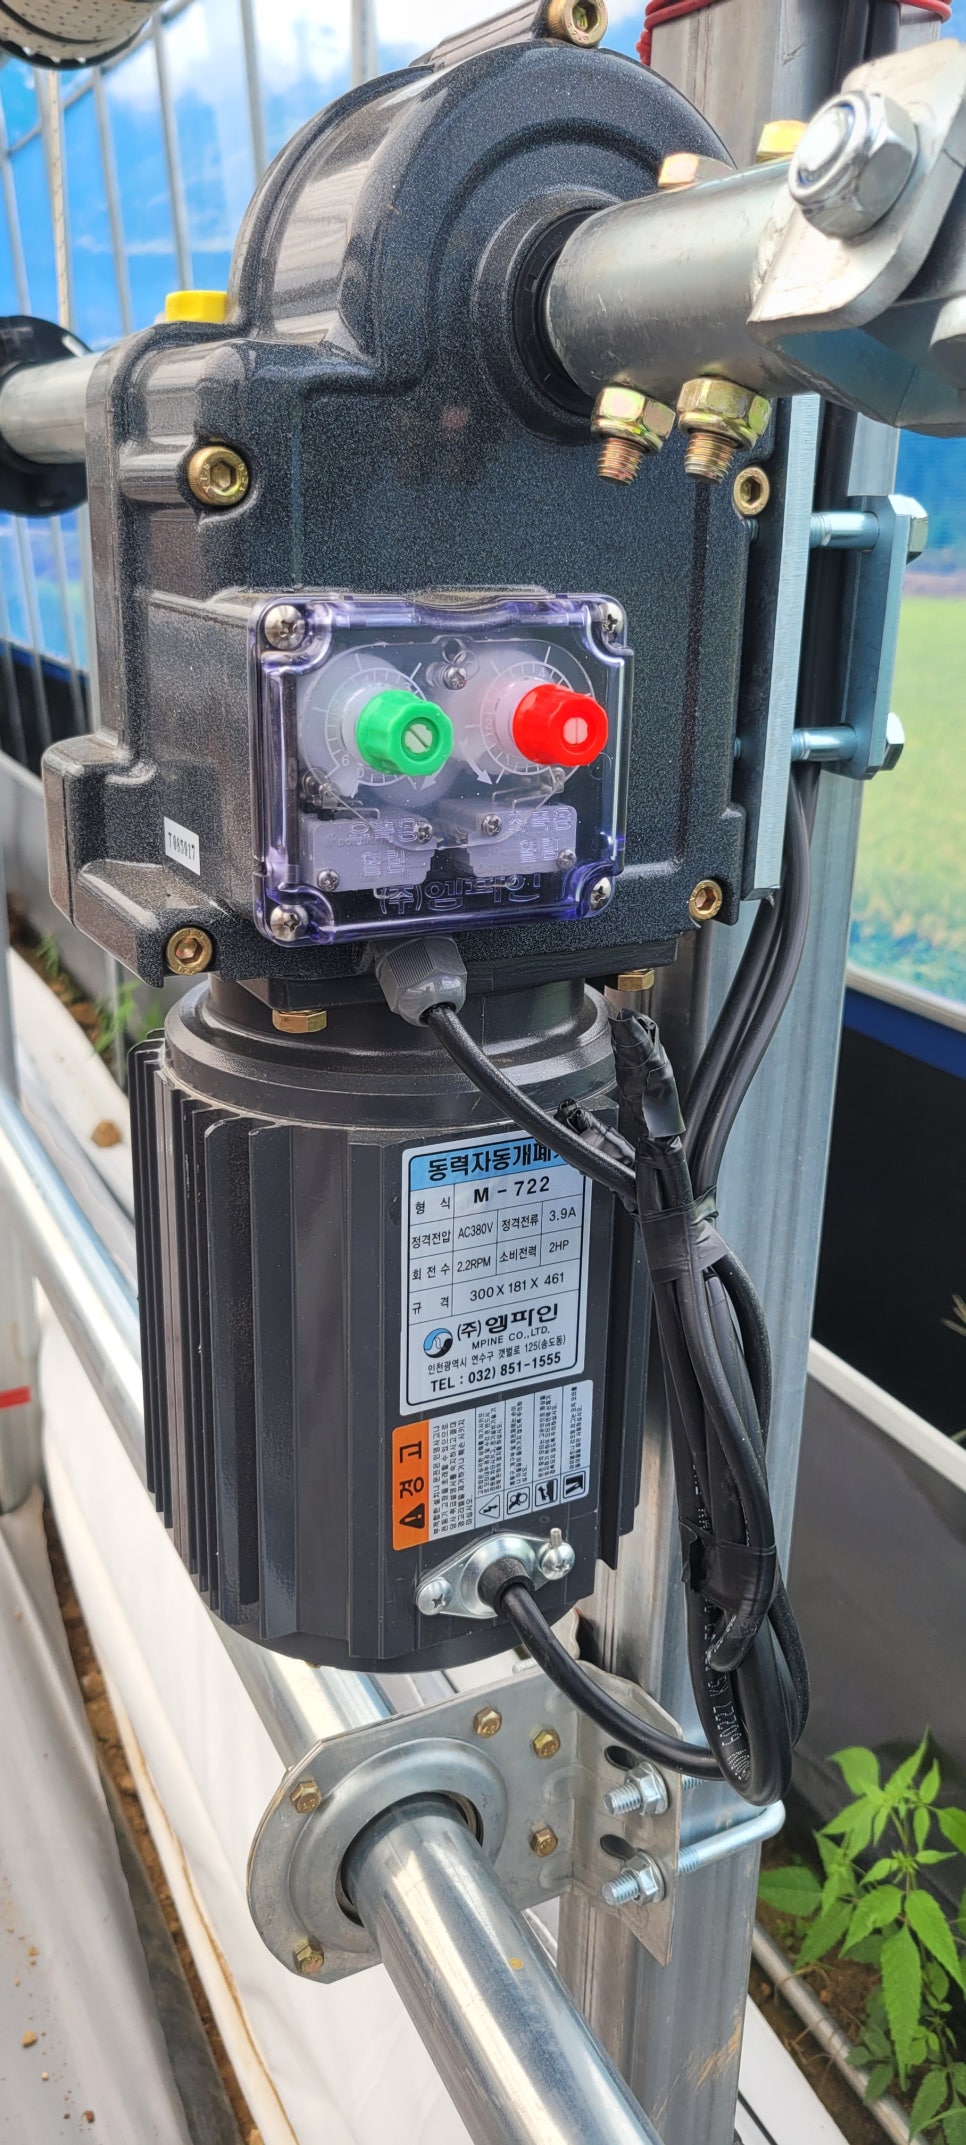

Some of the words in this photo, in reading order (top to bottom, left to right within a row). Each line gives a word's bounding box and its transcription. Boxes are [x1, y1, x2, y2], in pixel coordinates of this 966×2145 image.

[428, 1142, 564, 1182] 동력자동개폐
[501, 1213, 540, 1232] 정격전류
[549, 1207, 577, 1222] 3.9A
[411, 1231, 452, 1249] 정격전압
[458, 1221, 494, 1240] AC380V
[499, 1244, 537, 1263] 소비전력
[549, 1239, 570, 1253] 2HP
[457, 1255, 491, 1273] 2.2RPM
[470, 1286, 495, 1302] 300
[508, 1279, 527, 1294] 181
[544, 1271, 565, 1286] 461
[472, 1335, 504, 1350] MPINE
[428, 1357, 468, 1376] 인천광역시
[471, 1350, 495, 1366] 연수구
[497, 1344, 521, 1360] 갯벌로
[524, 1333, 566, 1353] 125(송도동)
[468, 1366, 496, 1384] 032)
[500, 1350, 562, 1377] 851-1555
[398, 1440, 422, 1464] 고
[431, 1424, 441, 1461] 인명사고나
[398, 1475, 424, 1499] 경
